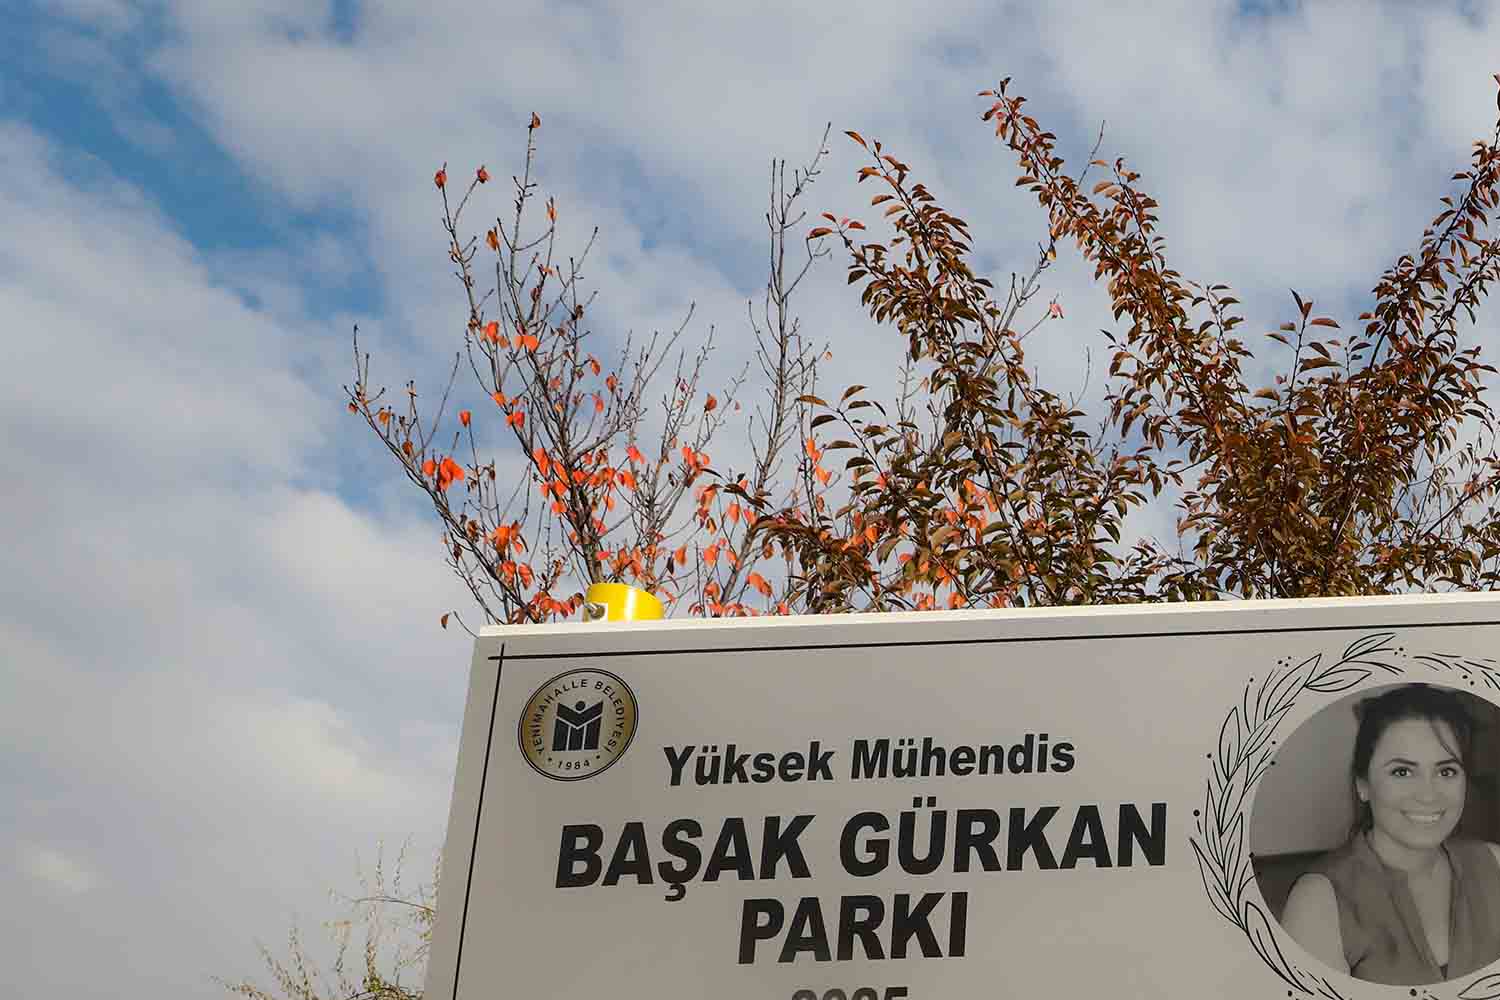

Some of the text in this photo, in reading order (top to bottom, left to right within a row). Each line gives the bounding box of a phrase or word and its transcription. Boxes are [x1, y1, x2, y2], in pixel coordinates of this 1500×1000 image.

[558, 759, 591, 770] 1984
[663, 733, 1076, 787] Yüksek Mühendis
[555, 795, 1167, 902] BAŞAK GÜRKAN
[737, 891, 969, 965] PARKI
